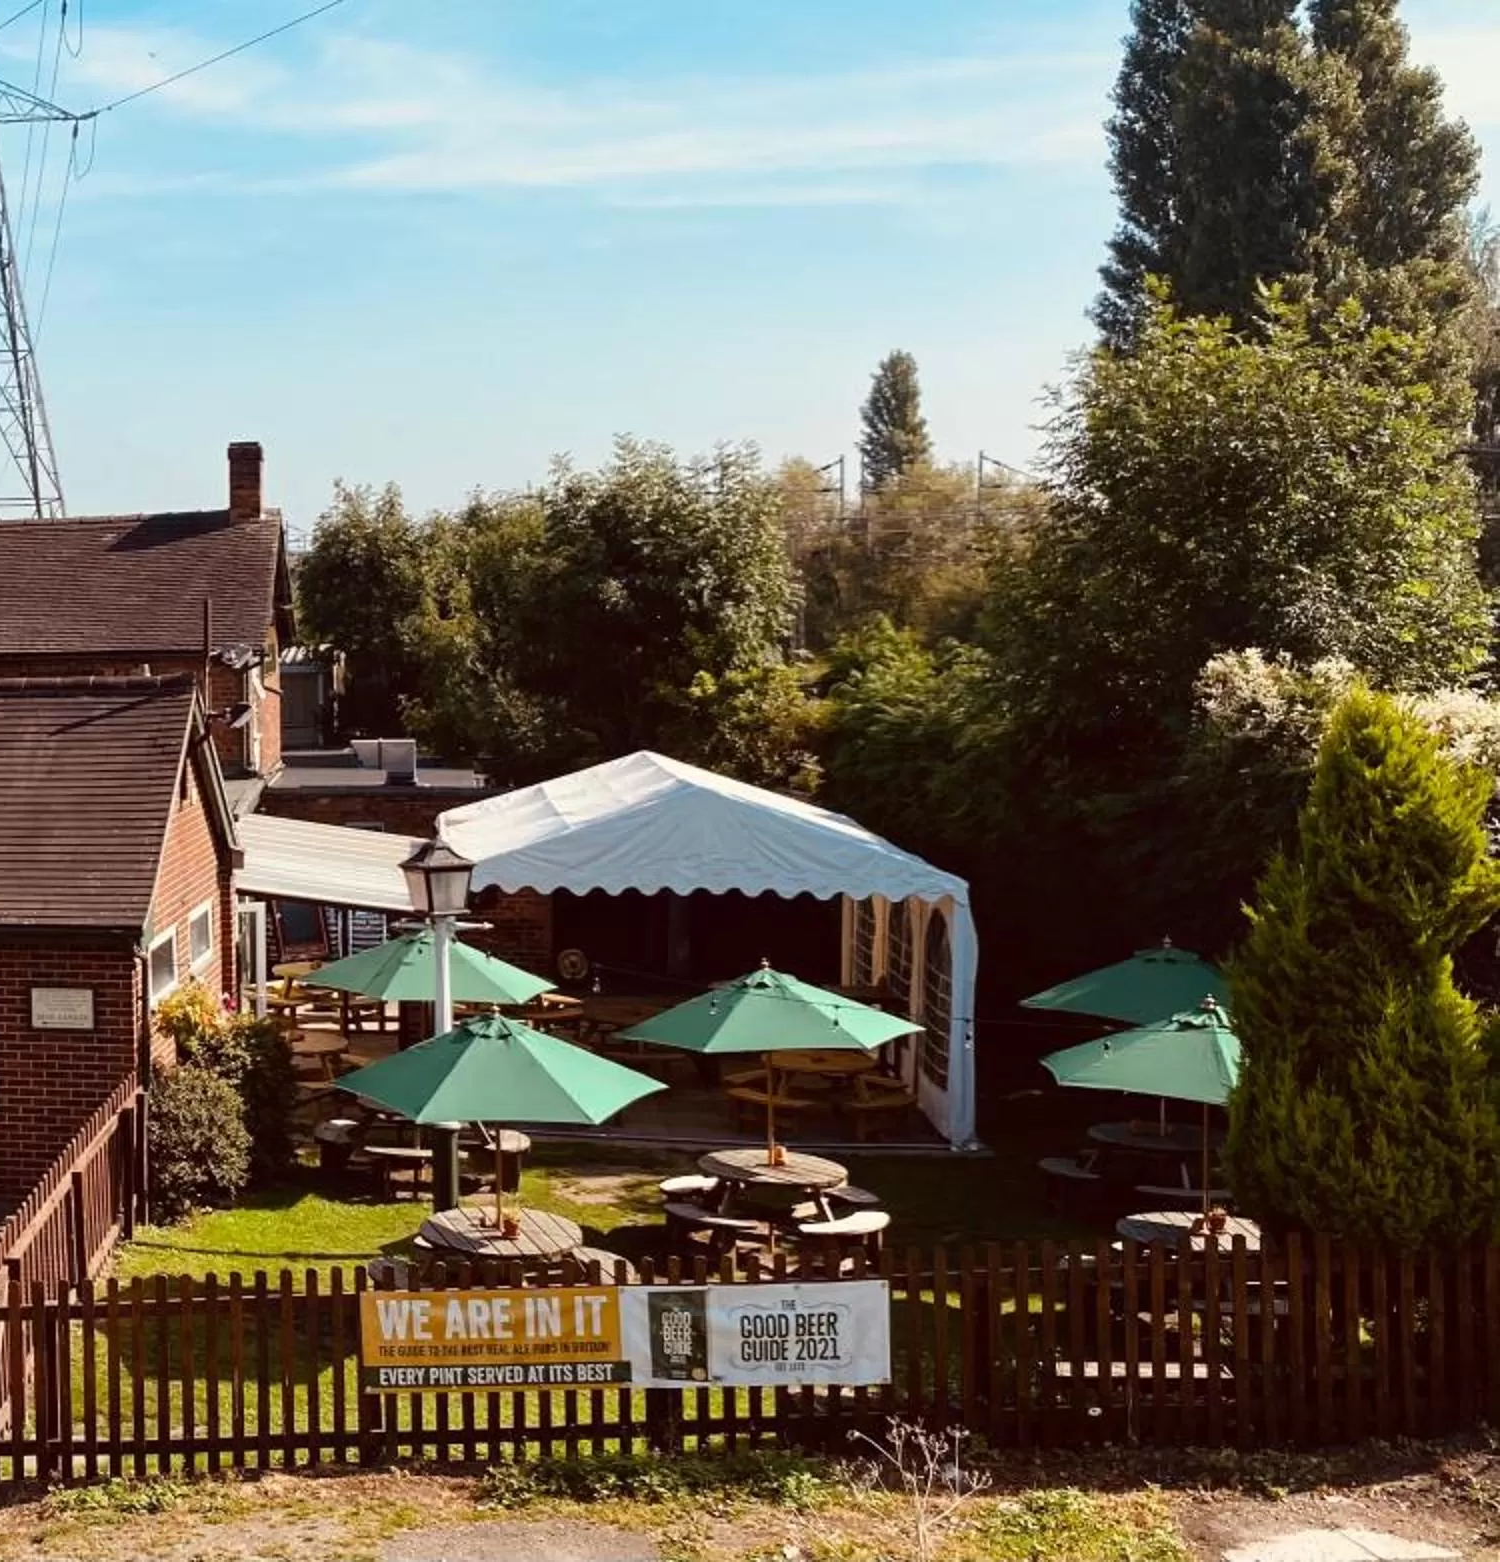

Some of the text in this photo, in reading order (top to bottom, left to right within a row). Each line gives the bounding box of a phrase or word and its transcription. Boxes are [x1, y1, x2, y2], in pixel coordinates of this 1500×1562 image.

[781, 1299, 796, 1311] THE
[376, 1295, 607, 1340] WE ARE IN IT
[662, 1311, 691, 1325] GOOD
[740, 1311, 840, 1339] GOOD BEER
[663, 1325, 693, 1341] BEER
[741, 1337, 841, 1362] GUIDE 2021
[380, 1363, 613, 1385] EVERY PINT SERVED AT ITS BEST
